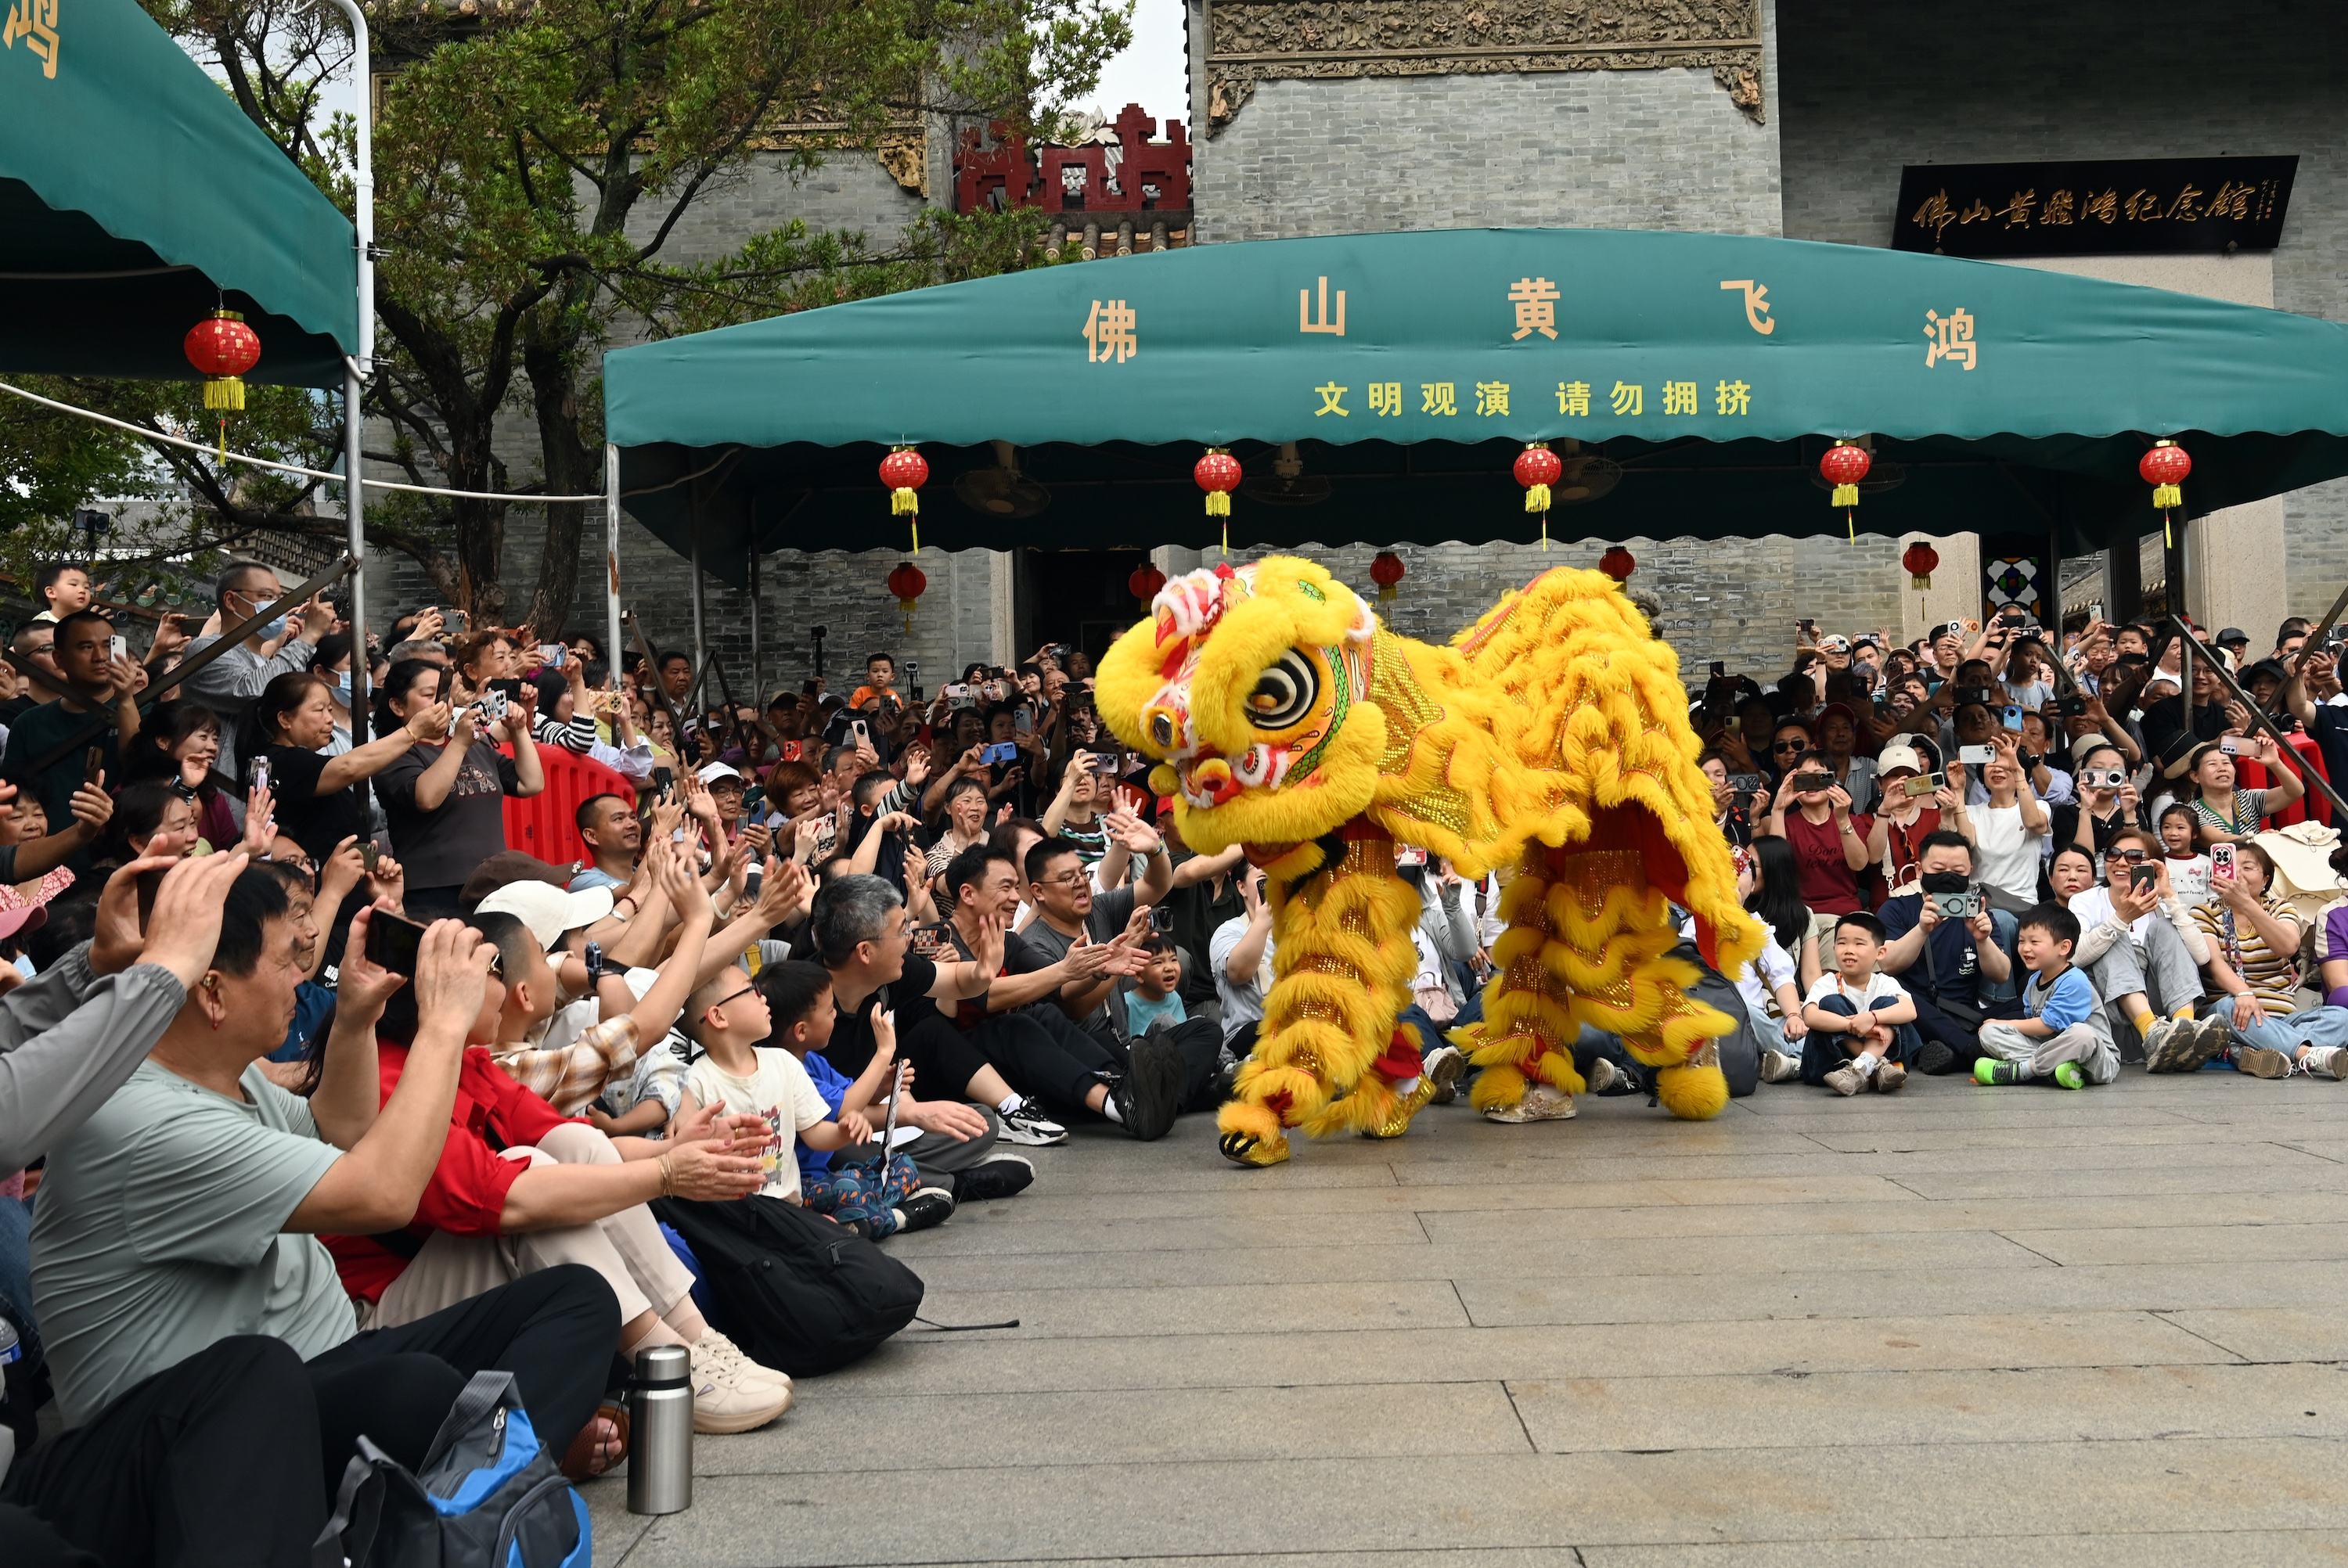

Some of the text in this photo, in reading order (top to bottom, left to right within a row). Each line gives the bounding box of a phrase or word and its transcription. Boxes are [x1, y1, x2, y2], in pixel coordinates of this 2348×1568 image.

[1082, 276, 1977, 371] 佛山黄飞鸿
[1314, 379, 1752, 418] 文明观演 请勿拥挤
